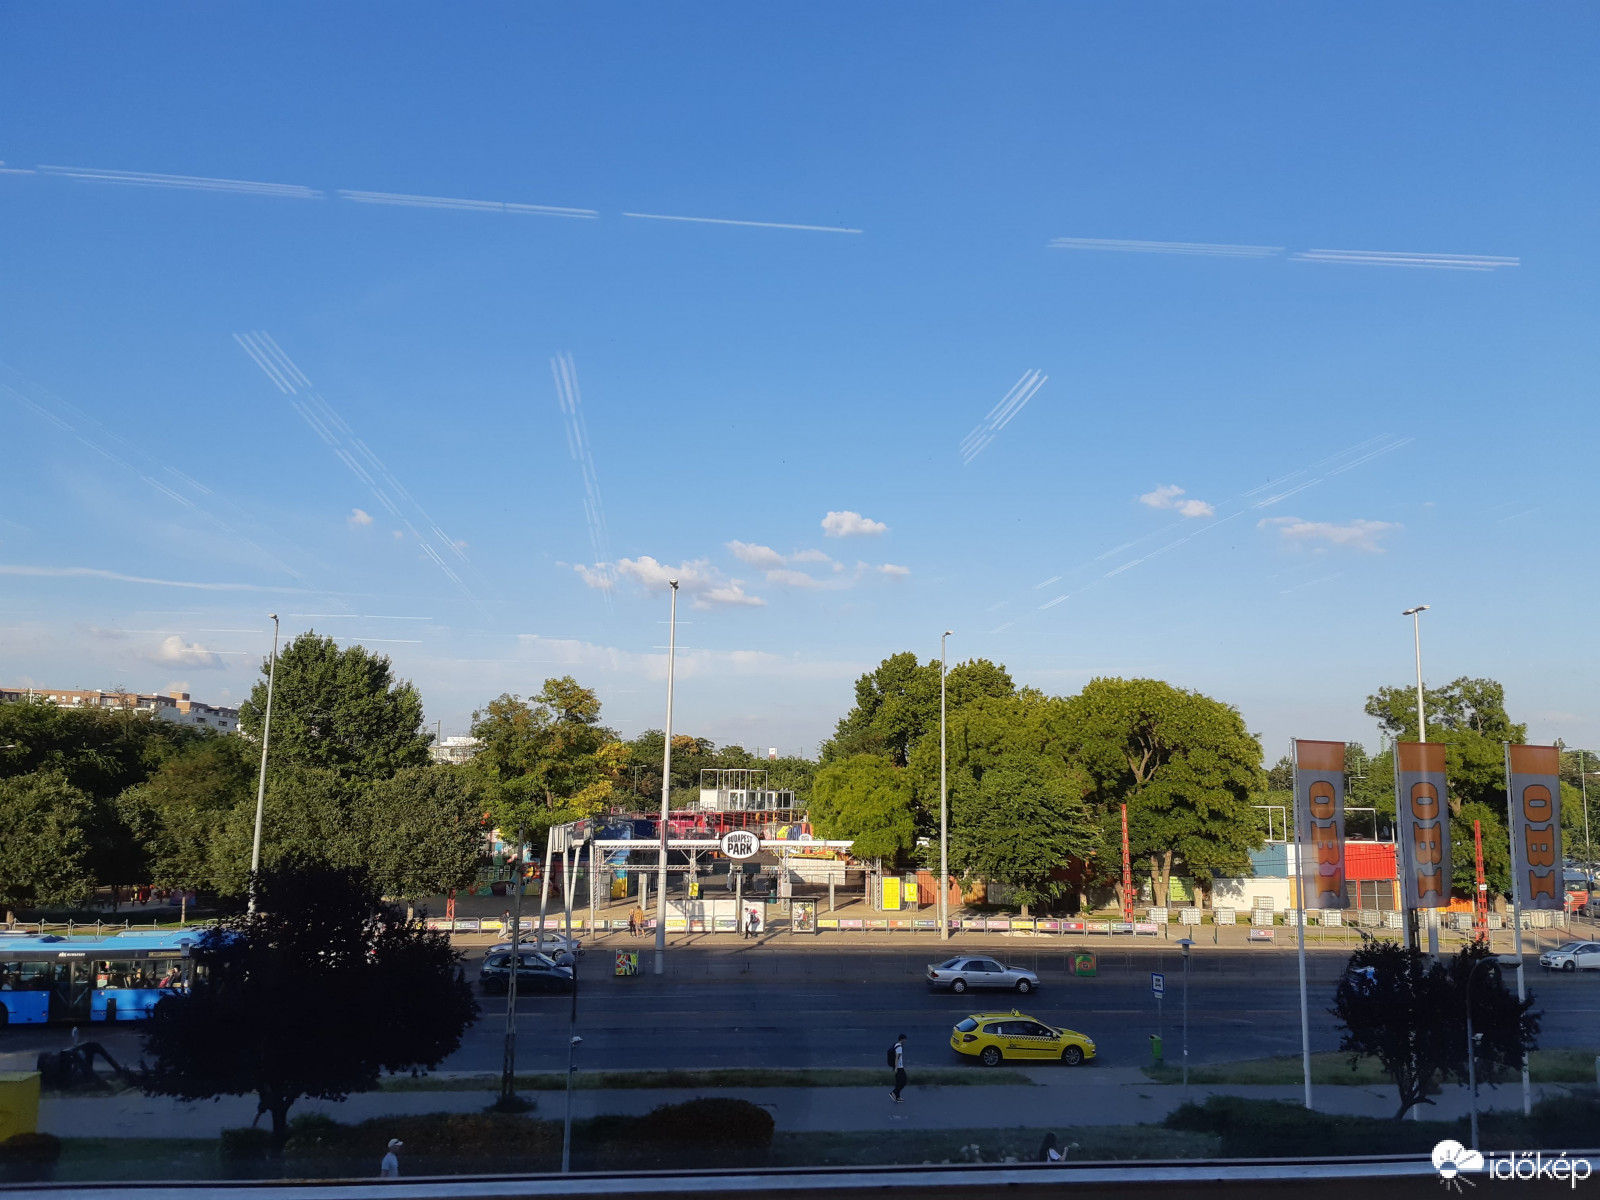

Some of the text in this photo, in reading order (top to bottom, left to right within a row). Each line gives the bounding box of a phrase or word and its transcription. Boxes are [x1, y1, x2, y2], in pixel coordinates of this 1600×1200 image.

[727, 834, 753, 843] BUDAPEST
[727, 842, 753, 856] PARK
[1308, 780, 1341, 898] OBI
[1411, 781, 1443, 899] OBI
[1523, 784, 1556, 900] OBI
